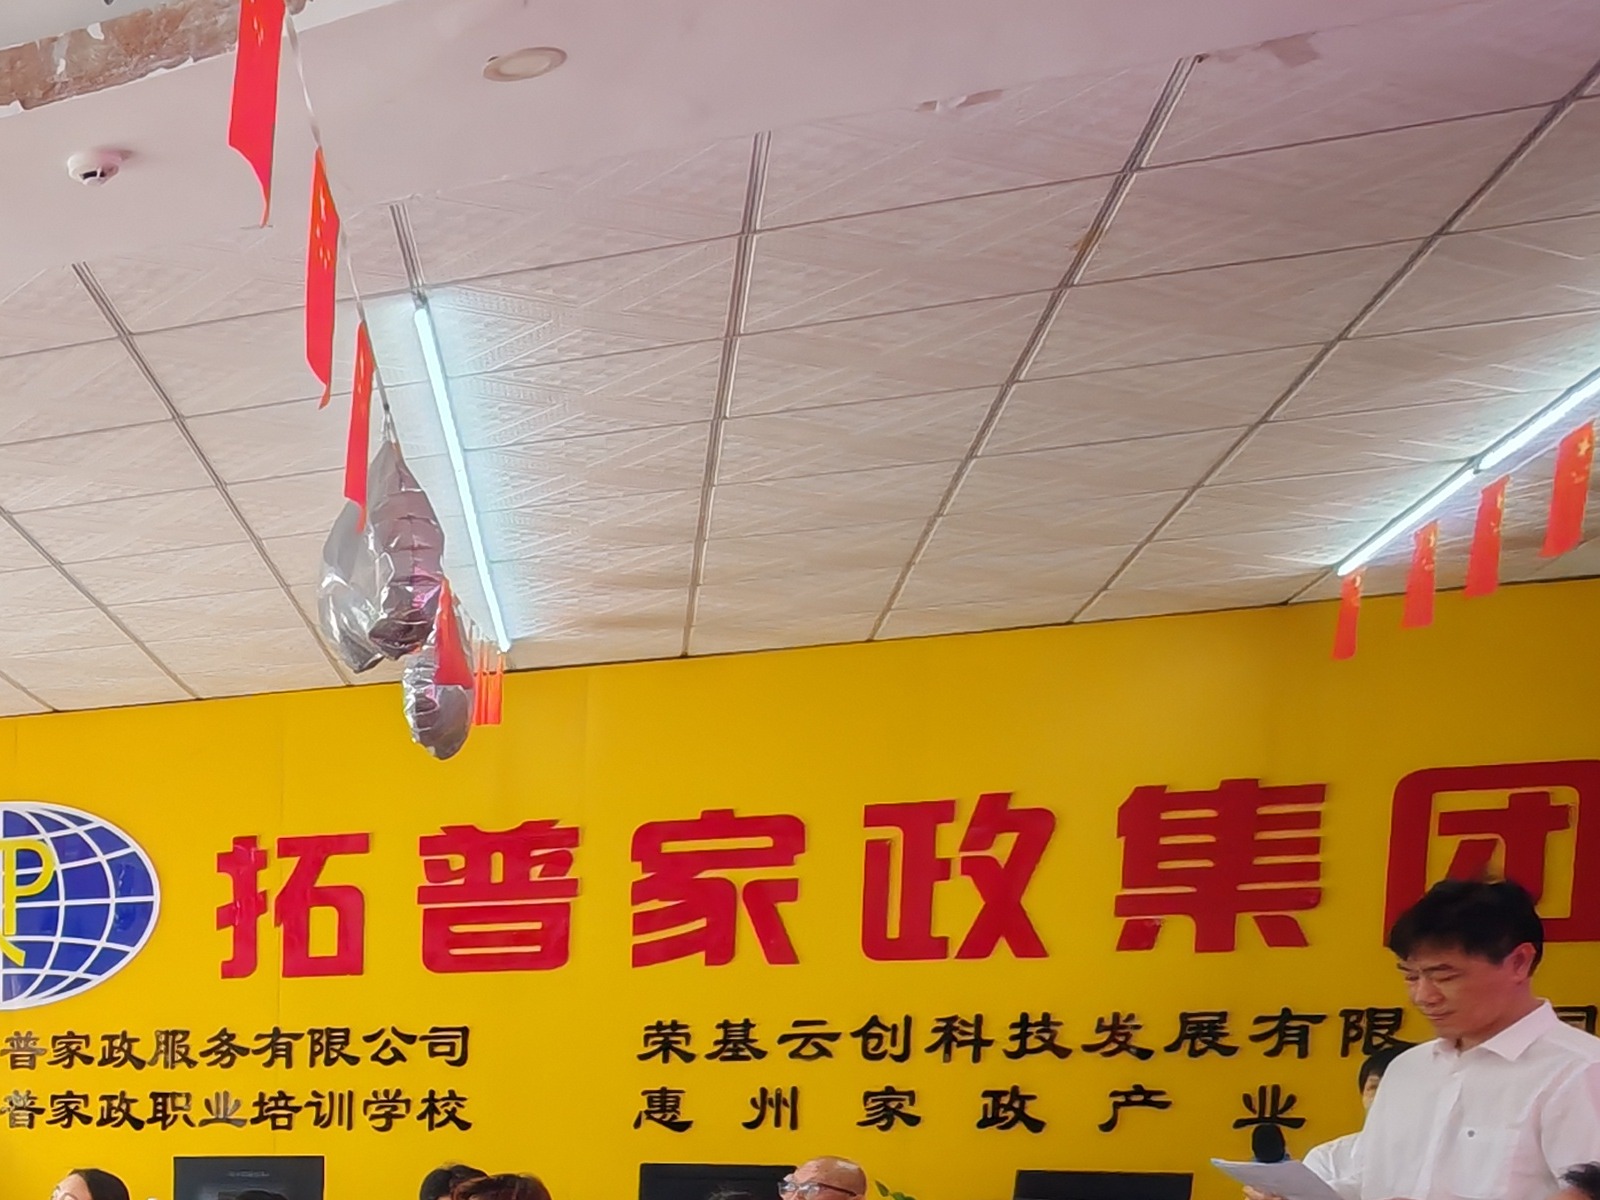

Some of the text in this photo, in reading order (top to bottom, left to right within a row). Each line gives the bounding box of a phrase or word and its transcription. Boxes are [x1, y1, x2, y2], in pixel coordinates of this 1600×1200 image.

[215, 759, 1600, 979] 拓普家政集团
[636, 1006, 1597, 1065] 荣基云创科技发展有限
